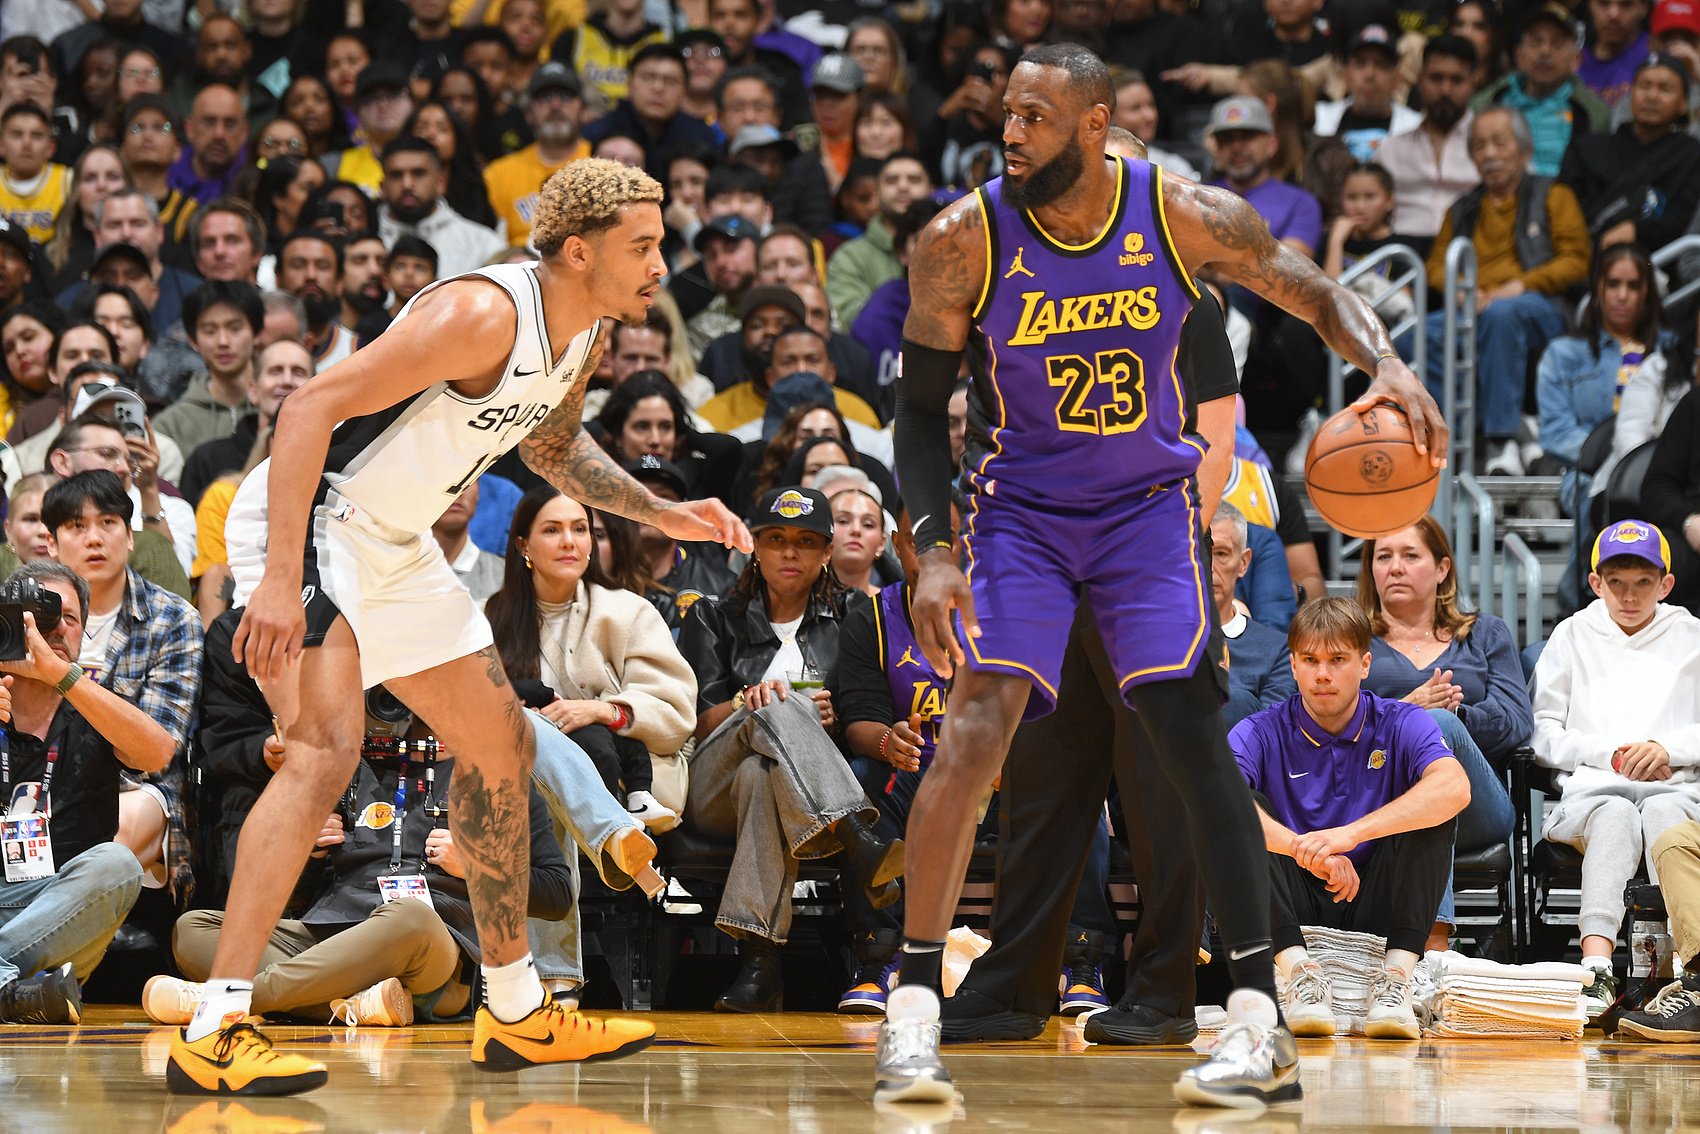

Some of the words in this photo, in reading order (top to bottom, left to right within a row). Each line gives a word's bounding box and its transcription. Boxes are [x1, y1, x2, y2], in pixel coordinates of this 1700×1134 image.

[1118, 252, 1154, 267] bibigo
[1007, 286, 1161, 346] LAKERS
[1045, 348, 1148, 436] 23
